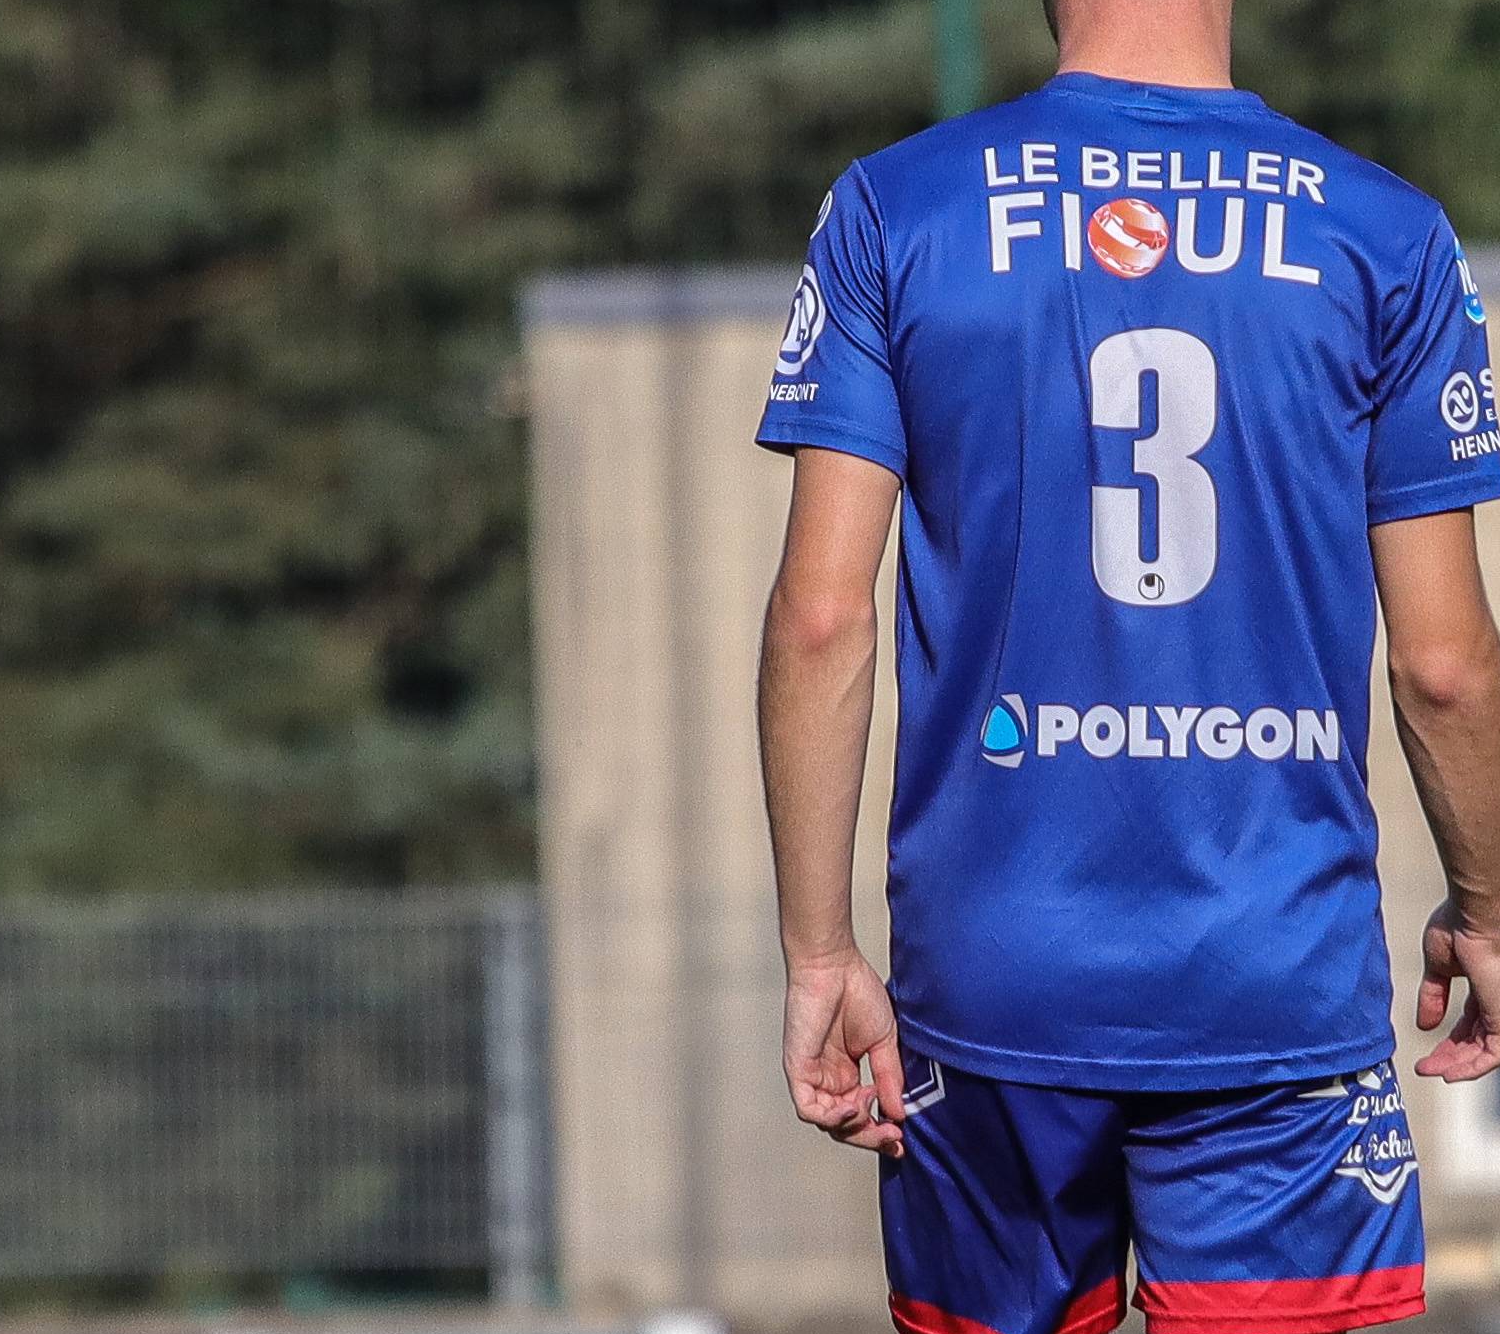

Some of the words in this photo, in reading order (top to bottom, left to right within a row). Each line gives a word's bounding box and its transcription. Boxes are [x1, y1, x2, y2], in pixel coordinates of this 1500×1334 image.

[983, 142, 1060, 188] LE
[1080, 145, 1327, 205] BELLER
[1089, 327, 1217, 606] 3
[1036, 703, 1341, 762] POLYGON
